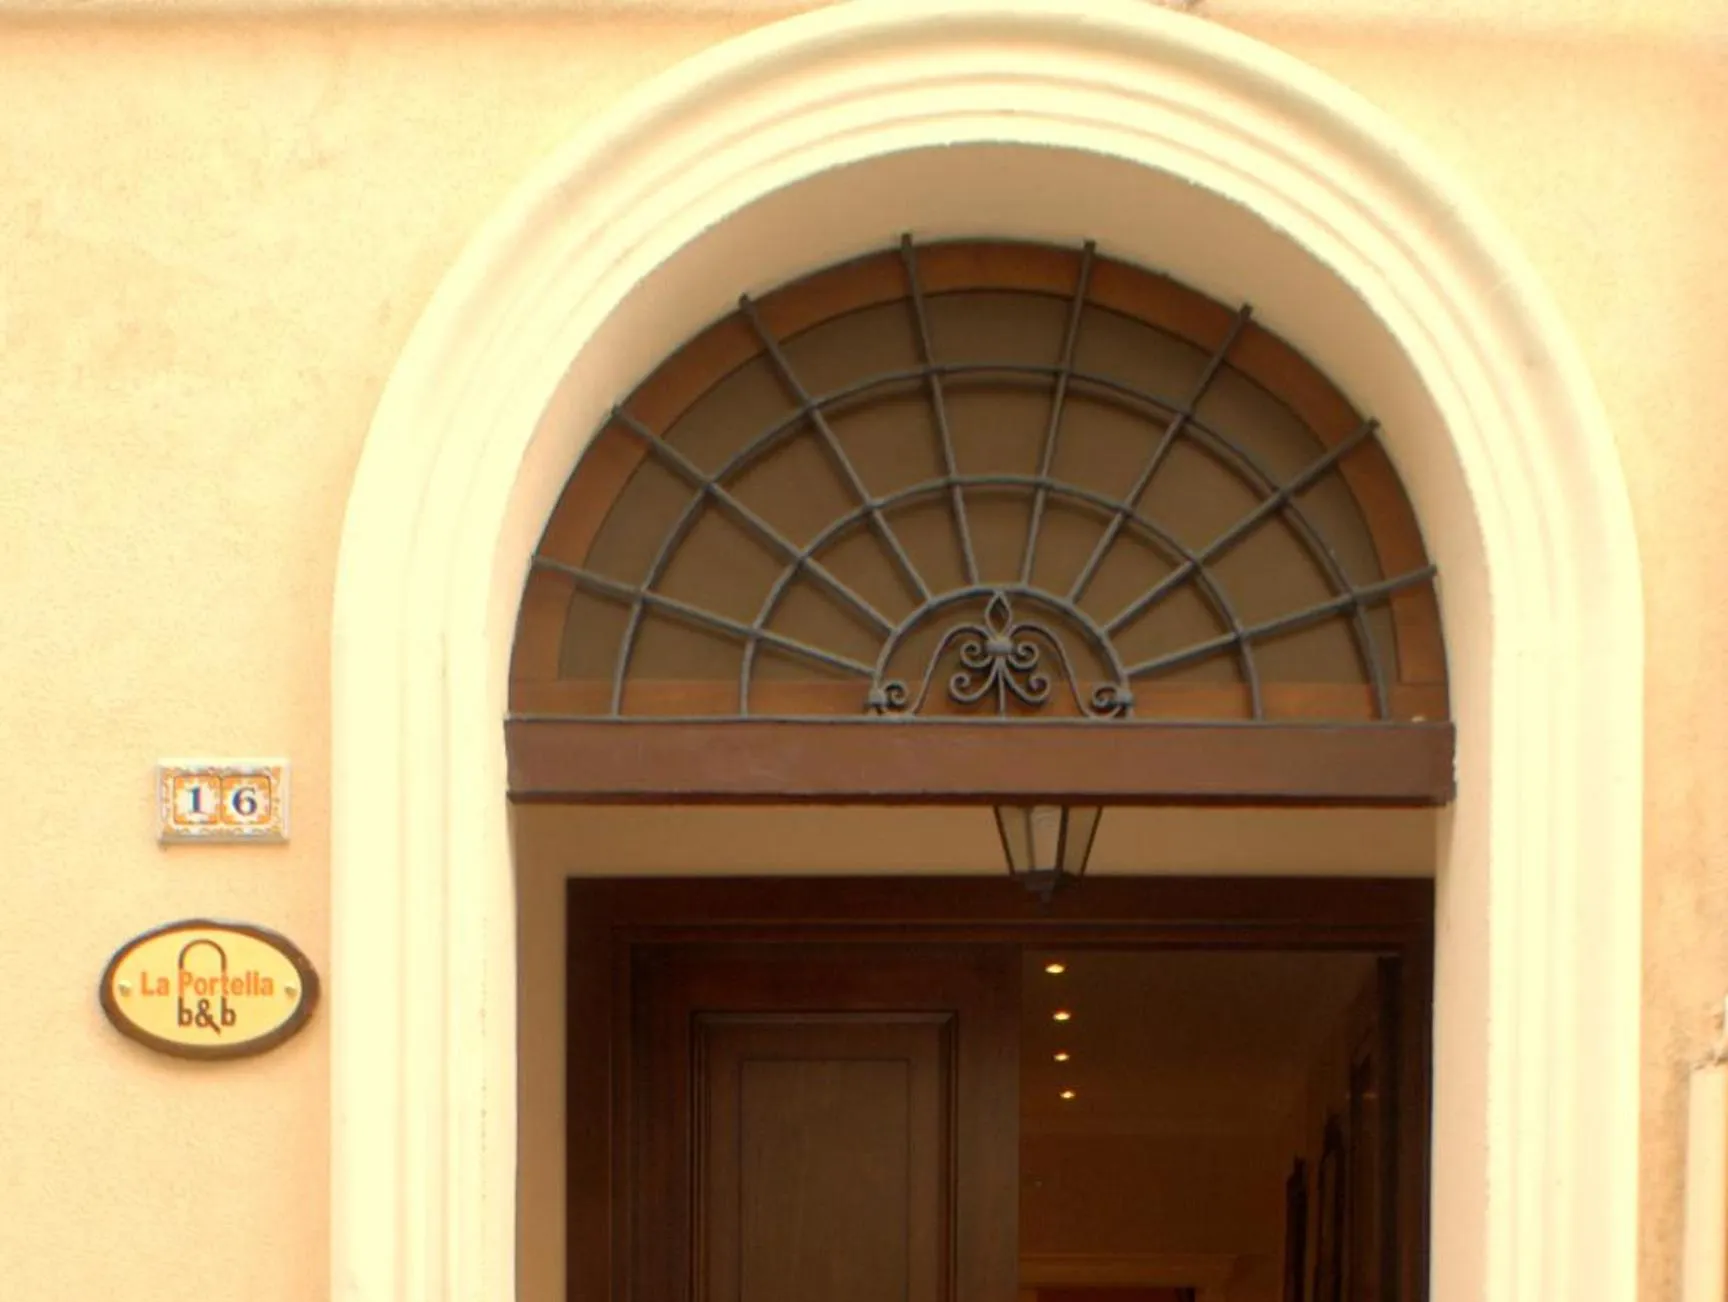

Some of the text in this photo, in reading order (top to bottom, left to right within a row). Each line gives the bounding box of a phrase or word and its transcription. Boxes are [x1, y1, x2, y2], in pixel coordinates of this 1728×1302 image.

[188, 786, 258, 816] 16
[140, 970, 274, 997] La Portella
[177, 996, 237, 1035] b&b
